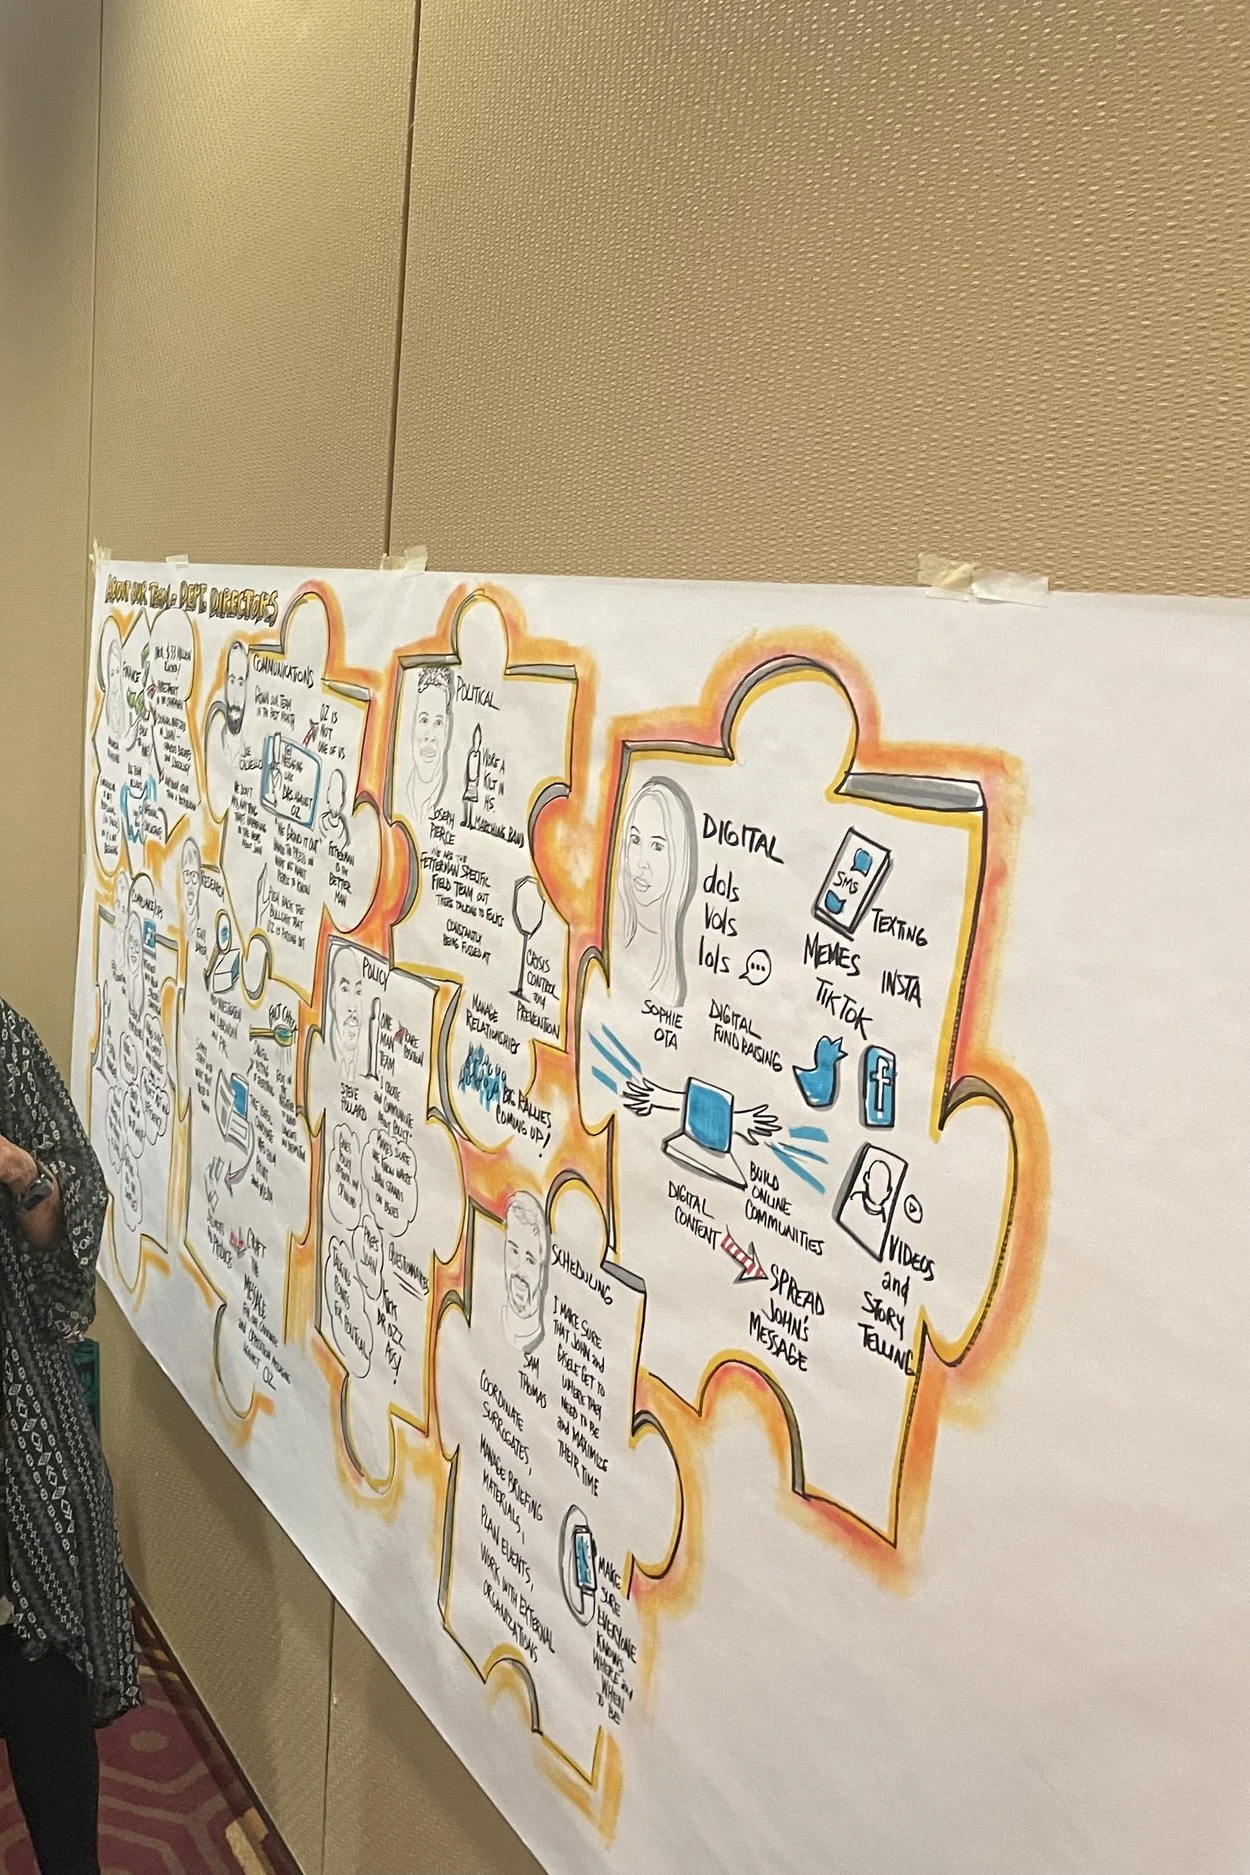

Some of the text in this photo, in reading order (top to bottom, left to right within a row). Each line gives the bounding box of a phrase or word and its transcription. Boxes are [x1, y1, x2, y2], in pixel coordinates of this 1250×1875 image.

[253, 654, 314, 688] COMMUNICATIONS
[456, 675, 500, 710] POLITICAL
[428, 805, 455, 830] JOSEPH
[430, 822, 455, 846] PIERCE
[703, 813, 784, 864] DIGITAL
[329, 875, 351, 894] BETTER
[421, 852, 491, 888] FETTERMAN SPECIFIC
[703, 864, 739, 901] dols
[432, 874, 489, 904] FIELD TEAM OUT
[486, 909, 504, 927] FOLKS
[872, 909, 928, 946] TEXTING
[443, 933, 459, 949] BEING
[699, 936, 730, 973] lols
[804, 932, 860, 976] MEMES
[362, 957, 389, 991] POLICY
[526, 950, 550, 973] CRISIS
[527, 972, 559, 1000] CONTROL
[881, 970, 922, 1007] INSTA
[472, 993, 498, 1023] MANAGE
[517, 1000, 560, 1039] PREVENTION
[641, 1000, 683, 1029] SOPHIE
[708, 999, 762, 1039] DIGITAL
[380, 1033, 394, 1053] MAN
[466, 1009, 520, 1055] RELATIONSHIPS
[654, 1027, 678, 1049] OTA
[496, 1104, 527, 1135] COMING
[518, 1090, 551, 1129] RALLIES
[750, 1161, 779, 1190] BUILD
[668, 1181, 714, 1219] DIGITAL
[752, 1186, 793, 1216] ONLINE
[675, 1206, 721, 1250] CONTENT
[745, 1199, 825, 1256] COMMUNITIES
[551, 1244, 612, 1305] SCHEDULING
[888, 1235, 935, 1281] VIDEOS
[770, 1264, 825, 1315] SPREAD
[553, 1296, 602, 1349] I MAKE SURE
[862, 1291, 904, 1340] STORY
[554, 1320, 569, 1345] THAT
[571, 1334, 590, 1363] JOHN
[750, 1312, 808, 1371] MESSAGE
[858, 1323, 915, 1375] TELLING
[523, 1352, 539, 1379] SAM
[581, 1367, 596, 1389] GET
[597, 1379, 605, 1397] TO
[480, 1369, 524, 1431] COORDINATE
[519, 1370, 547, 1408] THOMAS
[562, 1375, 602, 1420] WHERE THEY
[561, 1397, 600, 1438] NEED TO BE
[480, 1434, 542, 1521] MANAGE BRIEFING
[558, 1440, 599, 1497] THEIR TIME
[481, 1504, 499, 1546] PLAN
[600, 1556, 621, 1590] MAKE
[481, 1542, 500, 1586] WORK
[519, 1597, 554, 1654] EXTERNAL
[601, 1586, 620, 1618] SURE
[483, 1580, 538, 1662] ORGANIZATIONS
[597, 1605, 638, 1664] EVERYONE
[597, 1630, 624, 1672] KNOWS
[608, 1708, 621, 1725] BE
